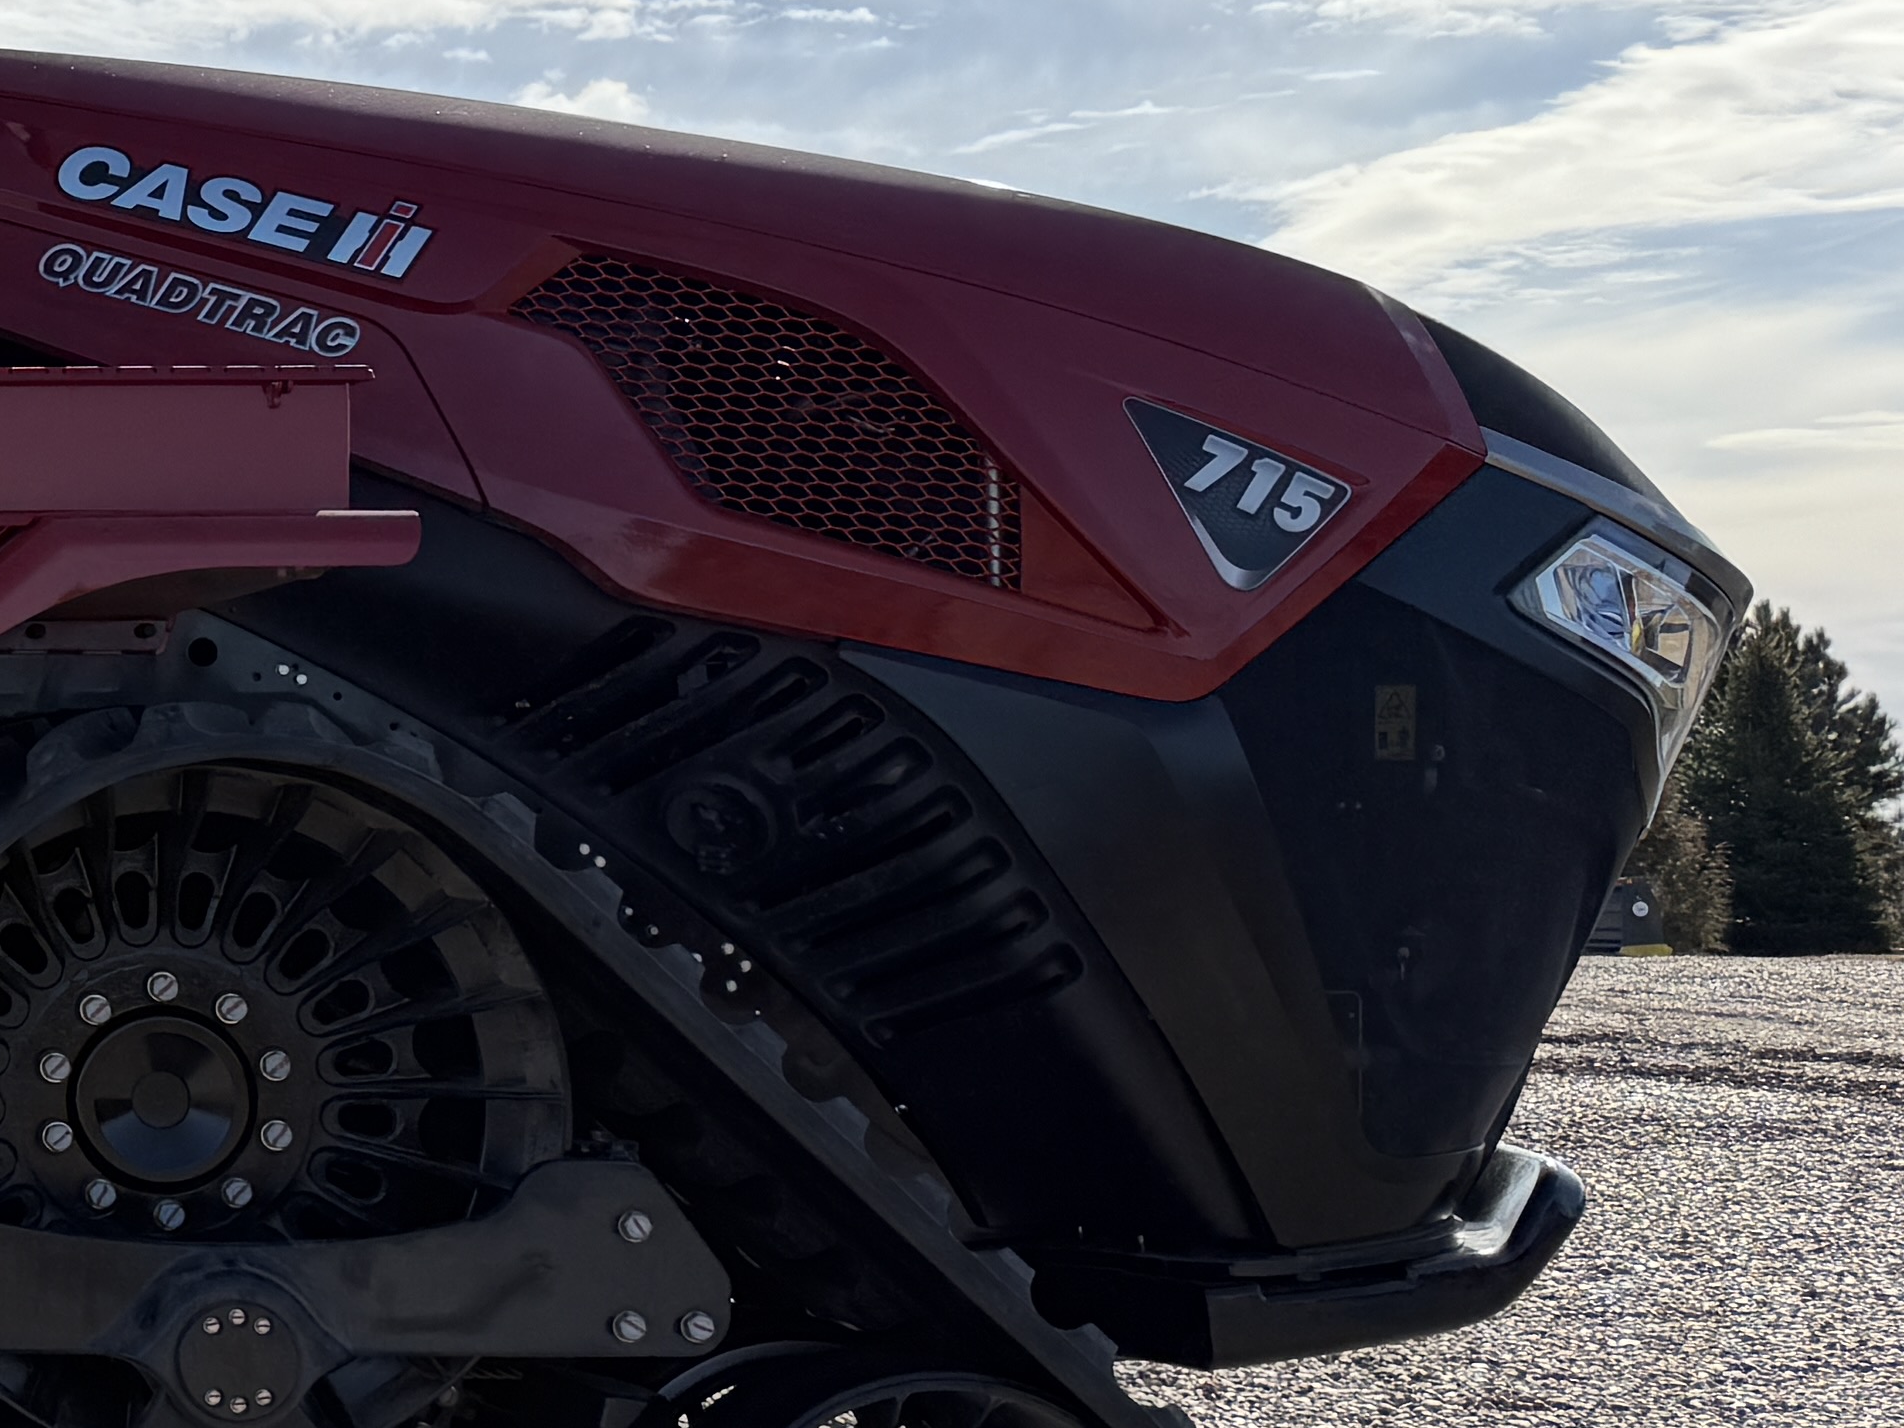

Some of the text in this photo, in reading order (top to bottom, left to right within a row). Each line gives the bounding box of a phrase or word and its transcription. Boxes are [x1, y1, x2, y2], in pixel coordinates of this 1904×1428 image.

[57, 146, 334, 253] CASE
[38, 243, 360, 357] QUADTRAC
[1183, 433, 1336, 533] 715
